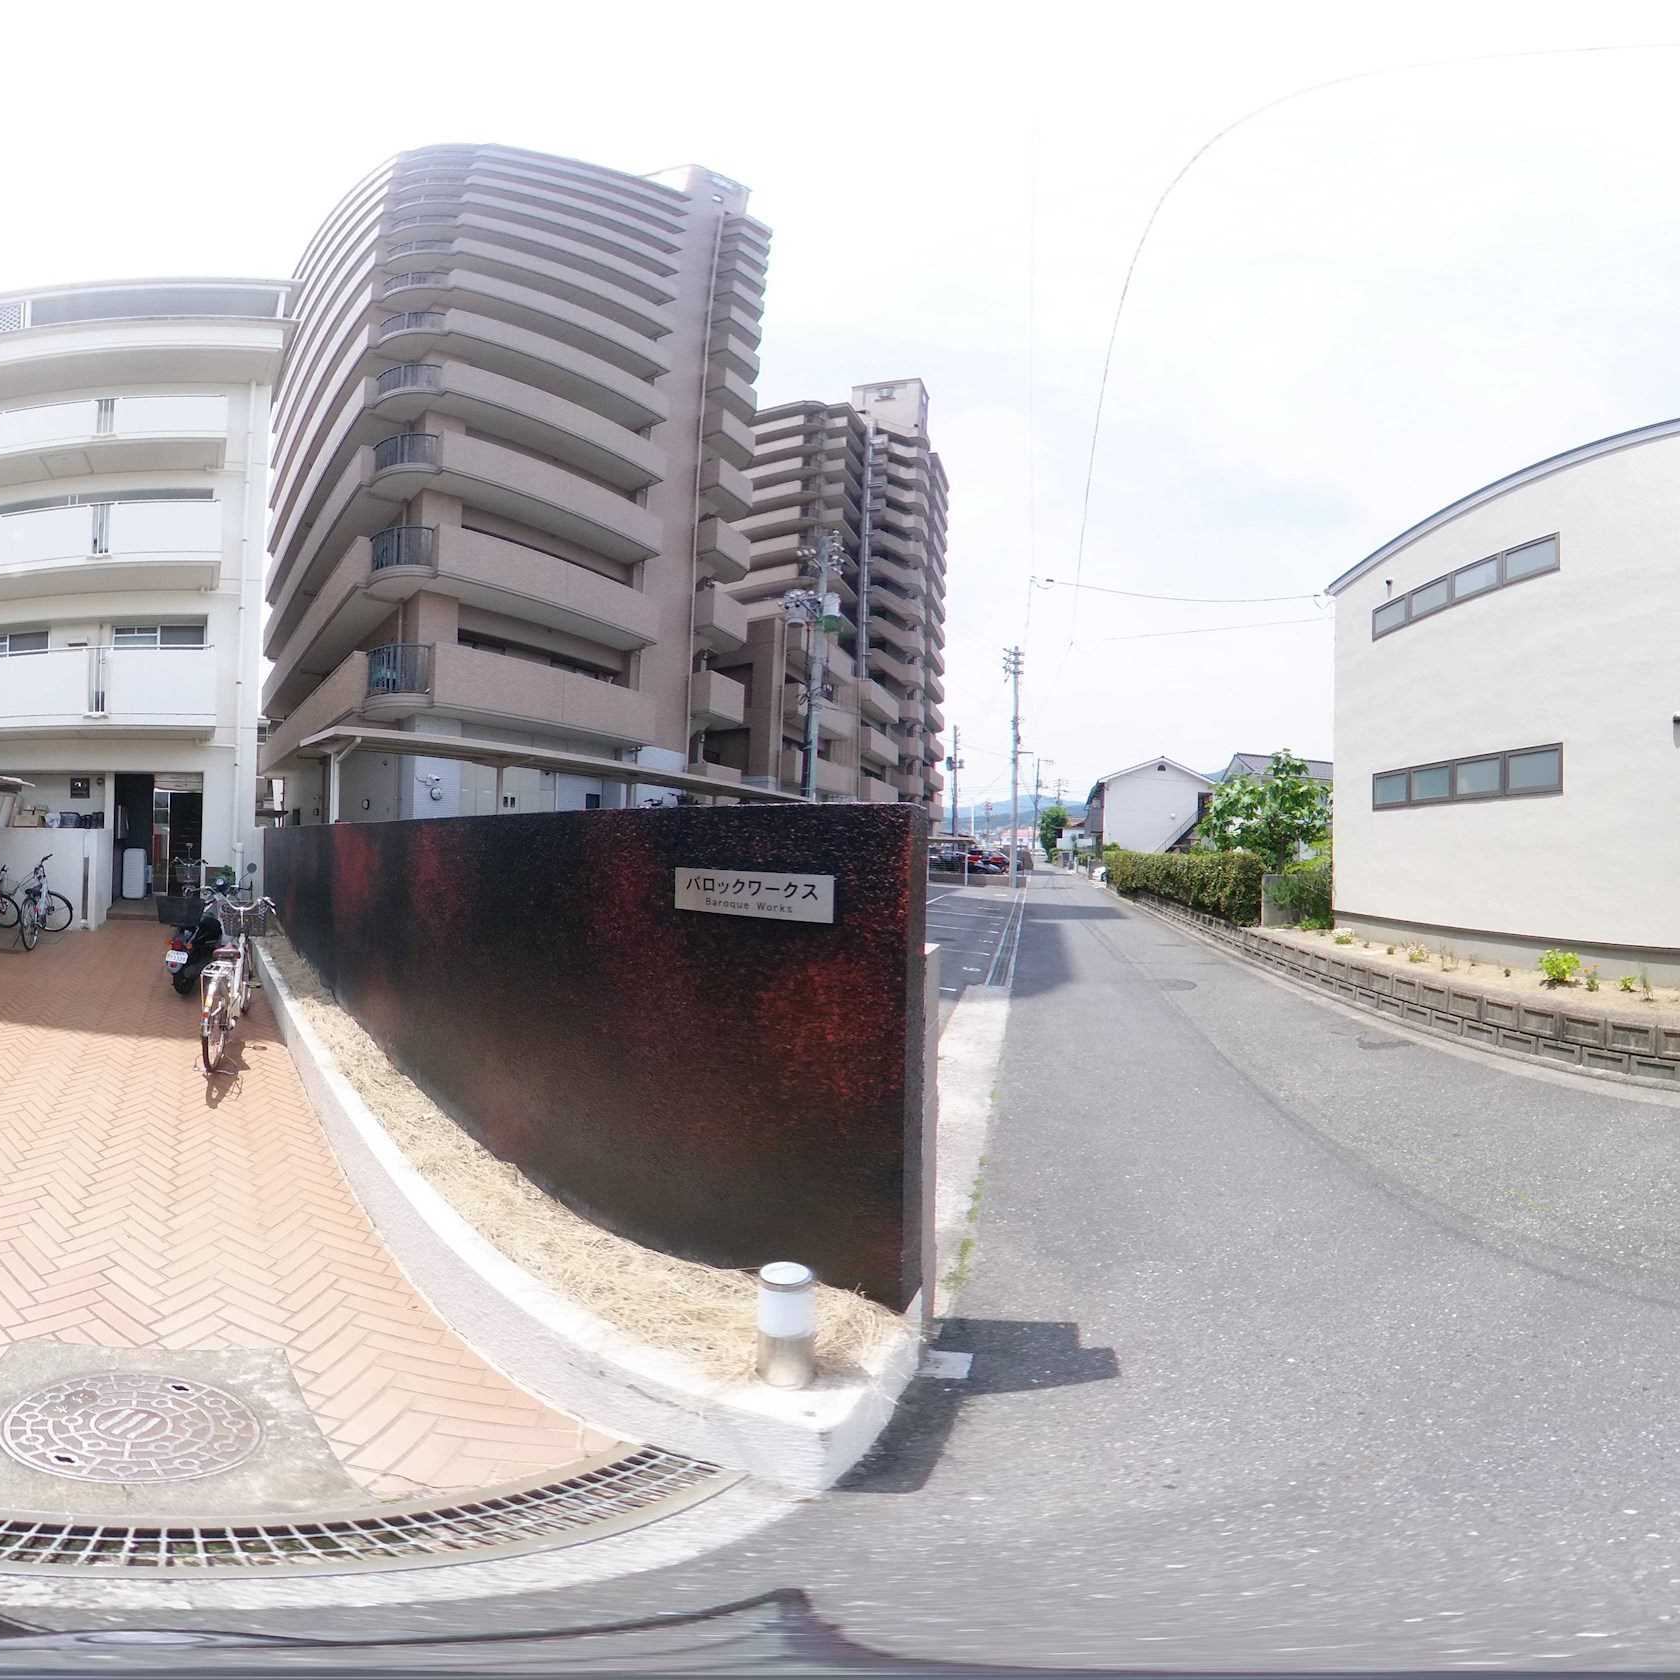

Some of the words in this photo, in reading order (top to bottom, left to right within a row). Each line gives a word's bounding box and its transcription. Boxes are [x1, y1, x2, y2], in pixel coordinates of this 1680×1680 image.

[686, 877, 819, 900] バロックワークス
[705, 898, 750, 911] Baroque
[757, 902, 793, 914] Works
